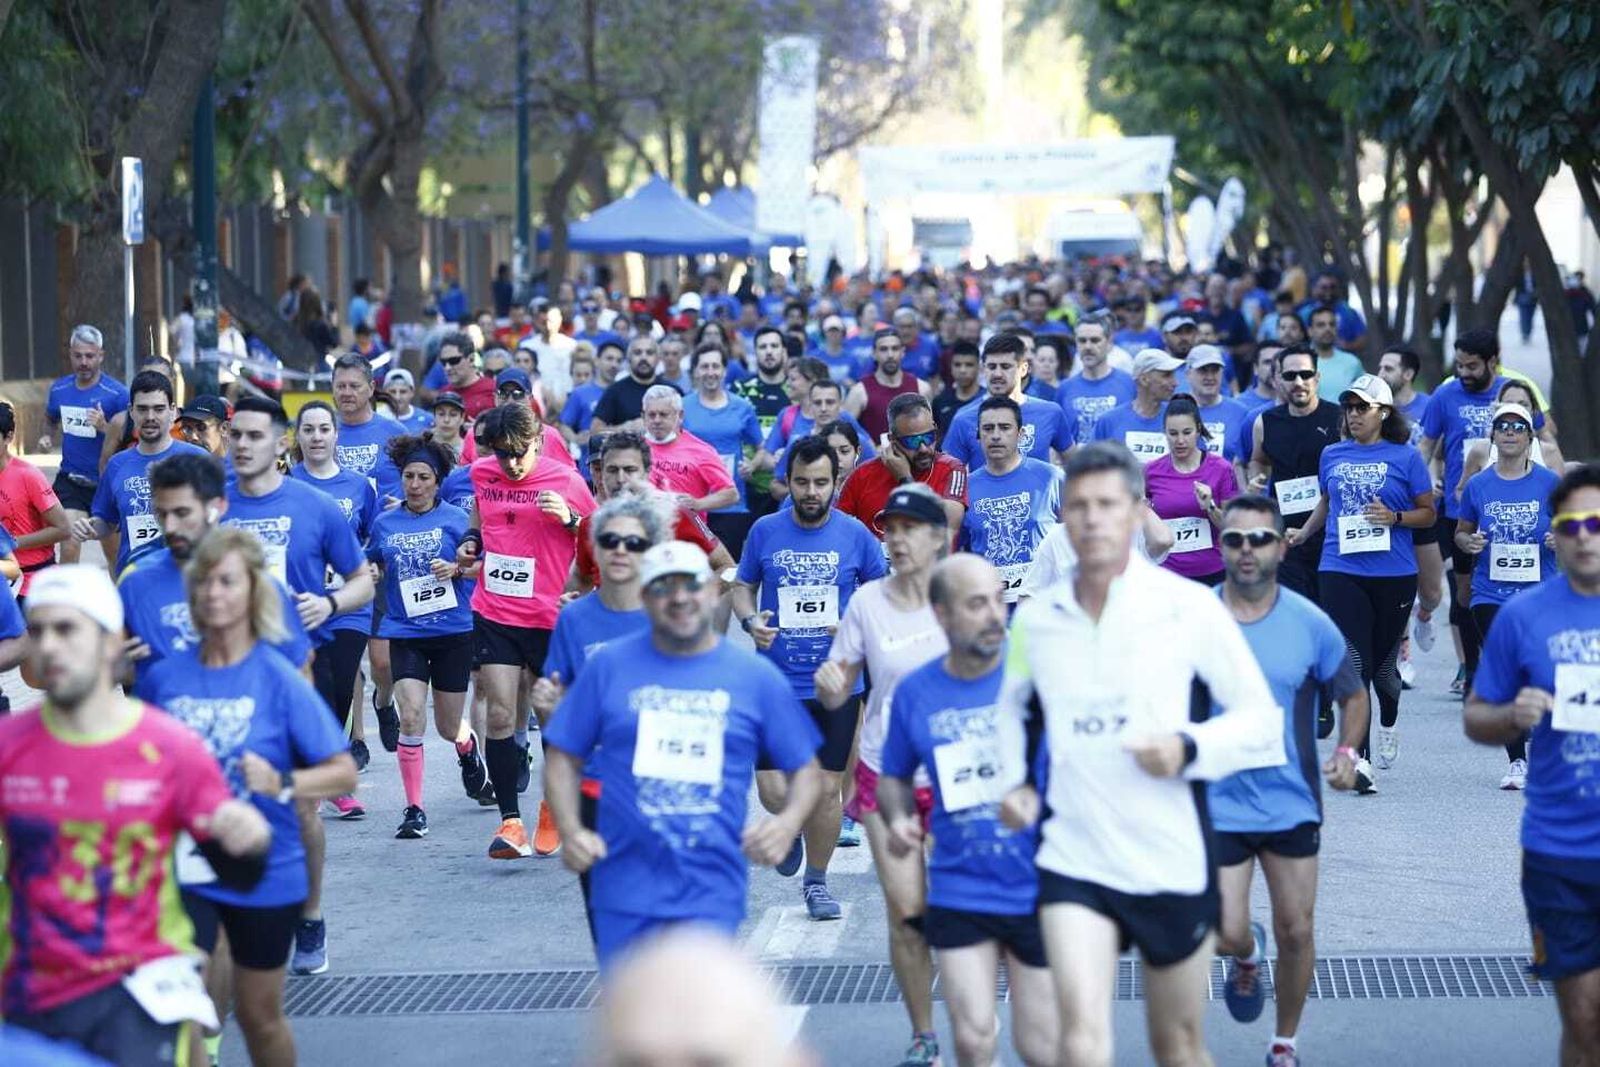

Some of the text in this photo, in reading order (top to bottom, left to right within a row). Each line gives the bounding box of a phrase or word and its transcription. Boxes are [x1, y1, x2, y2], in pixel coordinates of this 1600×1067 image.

[1283, 489, 1316, 502] 243
[1176, 528, 1200, 541] 171
[1346, 528, 1385, 540] 599
[1496, 558, 1535, 568] 633
[488, 569, 529, 583] 402
[413, 587, 446, 603] 129
[795, 601, 826, 613] 161
